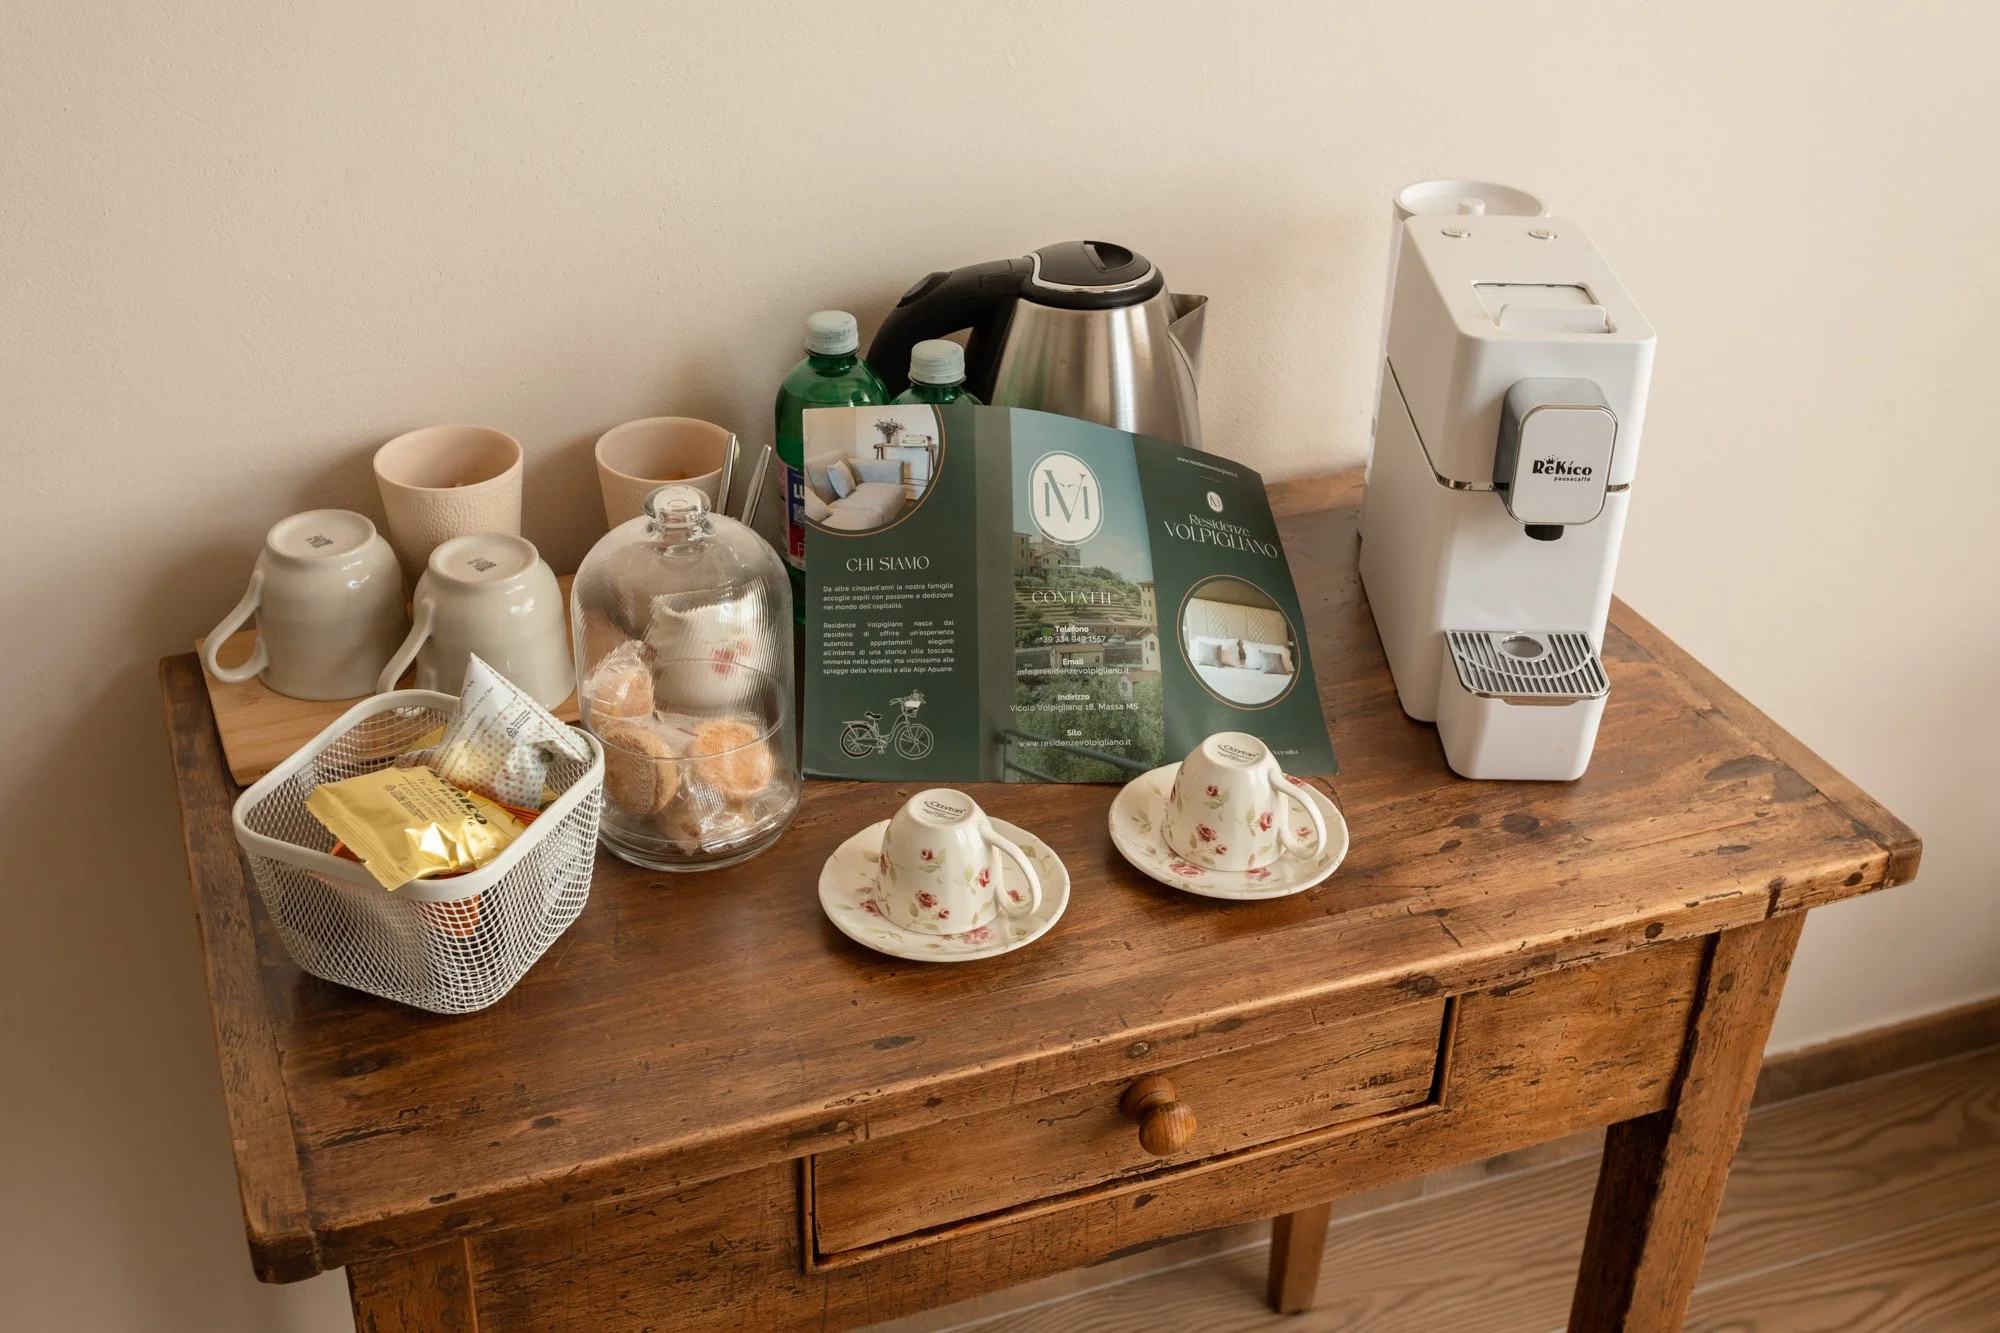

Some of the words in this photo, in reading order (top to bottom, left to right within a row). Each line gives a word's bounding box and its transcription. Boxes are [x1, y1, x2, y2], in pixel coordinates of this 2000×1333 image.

[1189, 514, 1250, 536] Residenze
[1164, 521, 1277, 558] VOLPIGLIANO
[846, 558, 873, 571] CHI
[880, 556, 929, 570] SIAMO
[1037, 704, 1082, 712] Volpigliano
[1018, 739, 1132, 747] www.residenzevolpigliano.it
